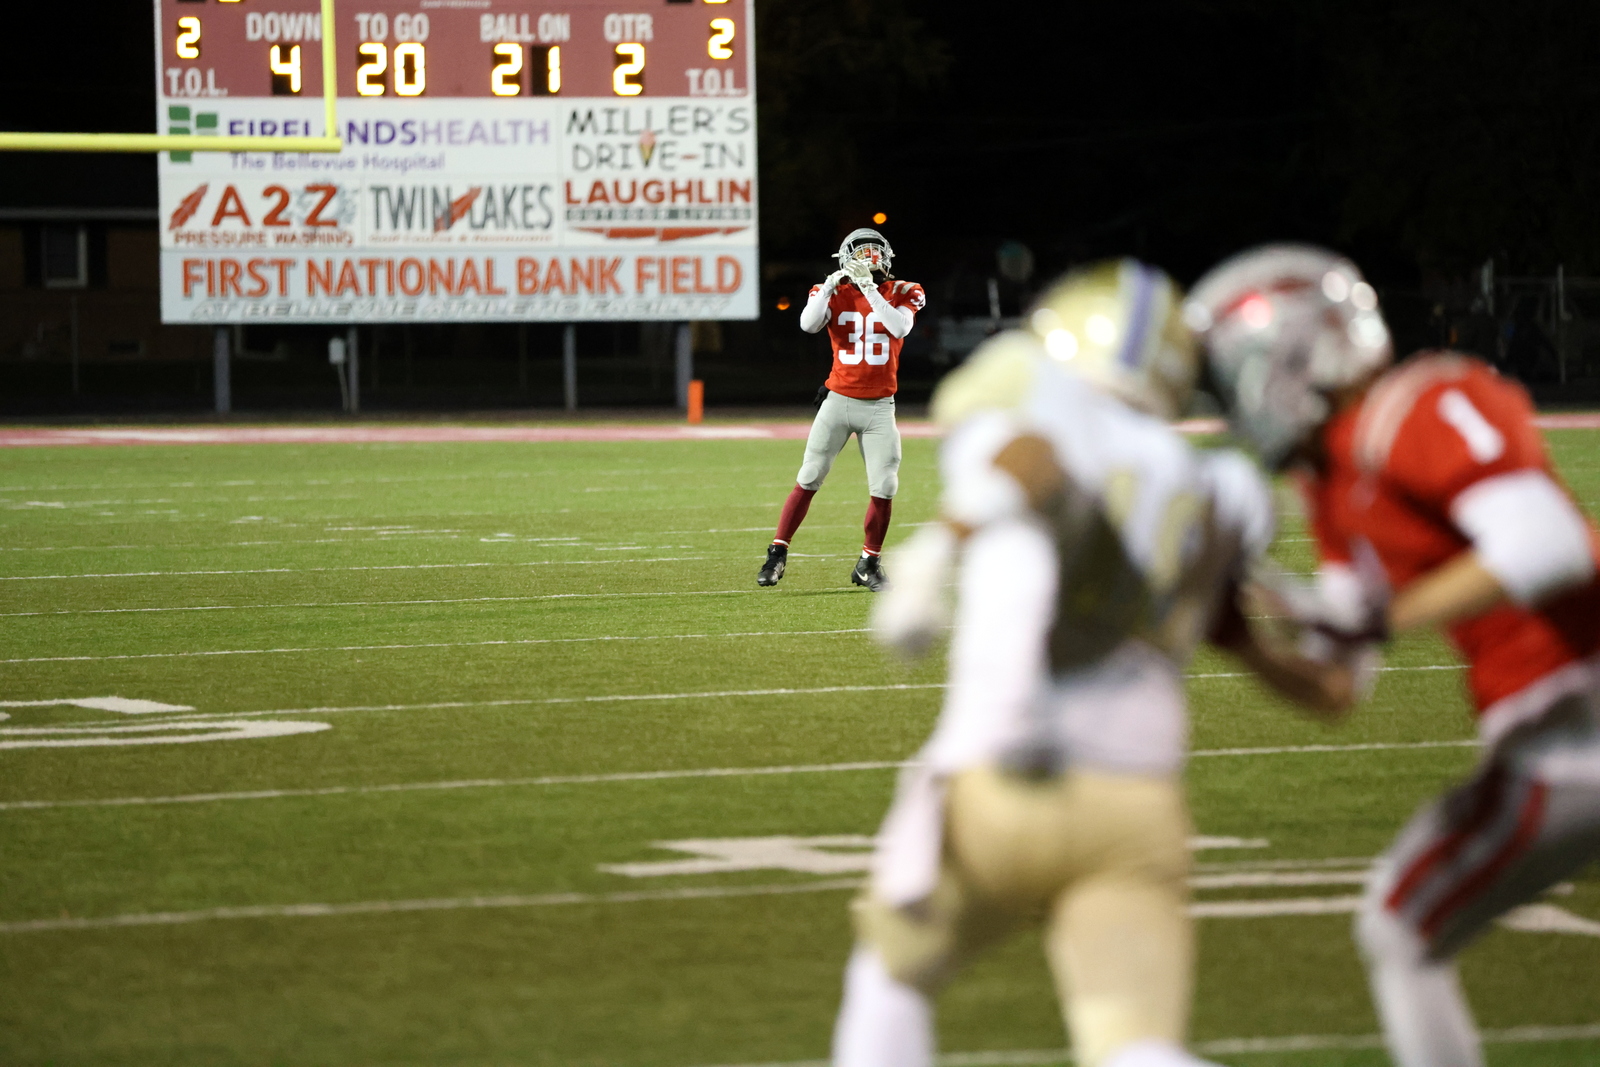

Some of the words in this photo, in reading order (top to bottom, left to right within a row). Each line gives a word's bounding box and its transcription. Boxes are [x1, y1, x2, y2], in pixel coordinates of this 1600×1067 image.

[176, 16, 201, 59] 2
[246, 12, 322, 41] DOWN
[356, 14, 388, 41] TO
[394, 14, 430, 42] GO
[480, 14, 534, 42] BALL
[538, 14, 570, 41] ON
[708, 17, 735, 60] 2
[270, 44, 302, 93] 4
[356, 42, 426, 96] 20
[491, 42, 562, 97] 21
[613, 42, 646, 96] 2
[566, 107, 750, 136] MILLER'S
[370, 185, 451, 231] TWIN
[469, 185, 553, 229] LAKES
[565, 180, 751, 204] LAUGHLIN
[182, 258, 296, 297] FIRST
[306, 257, 505, 297] NATIONAL
[517, 257, 623, 295] BANK
[634, 255, 742, 294] FIELD
[837, 311, 890, 365] 36
[1436, 388, 1505, 464] 1
